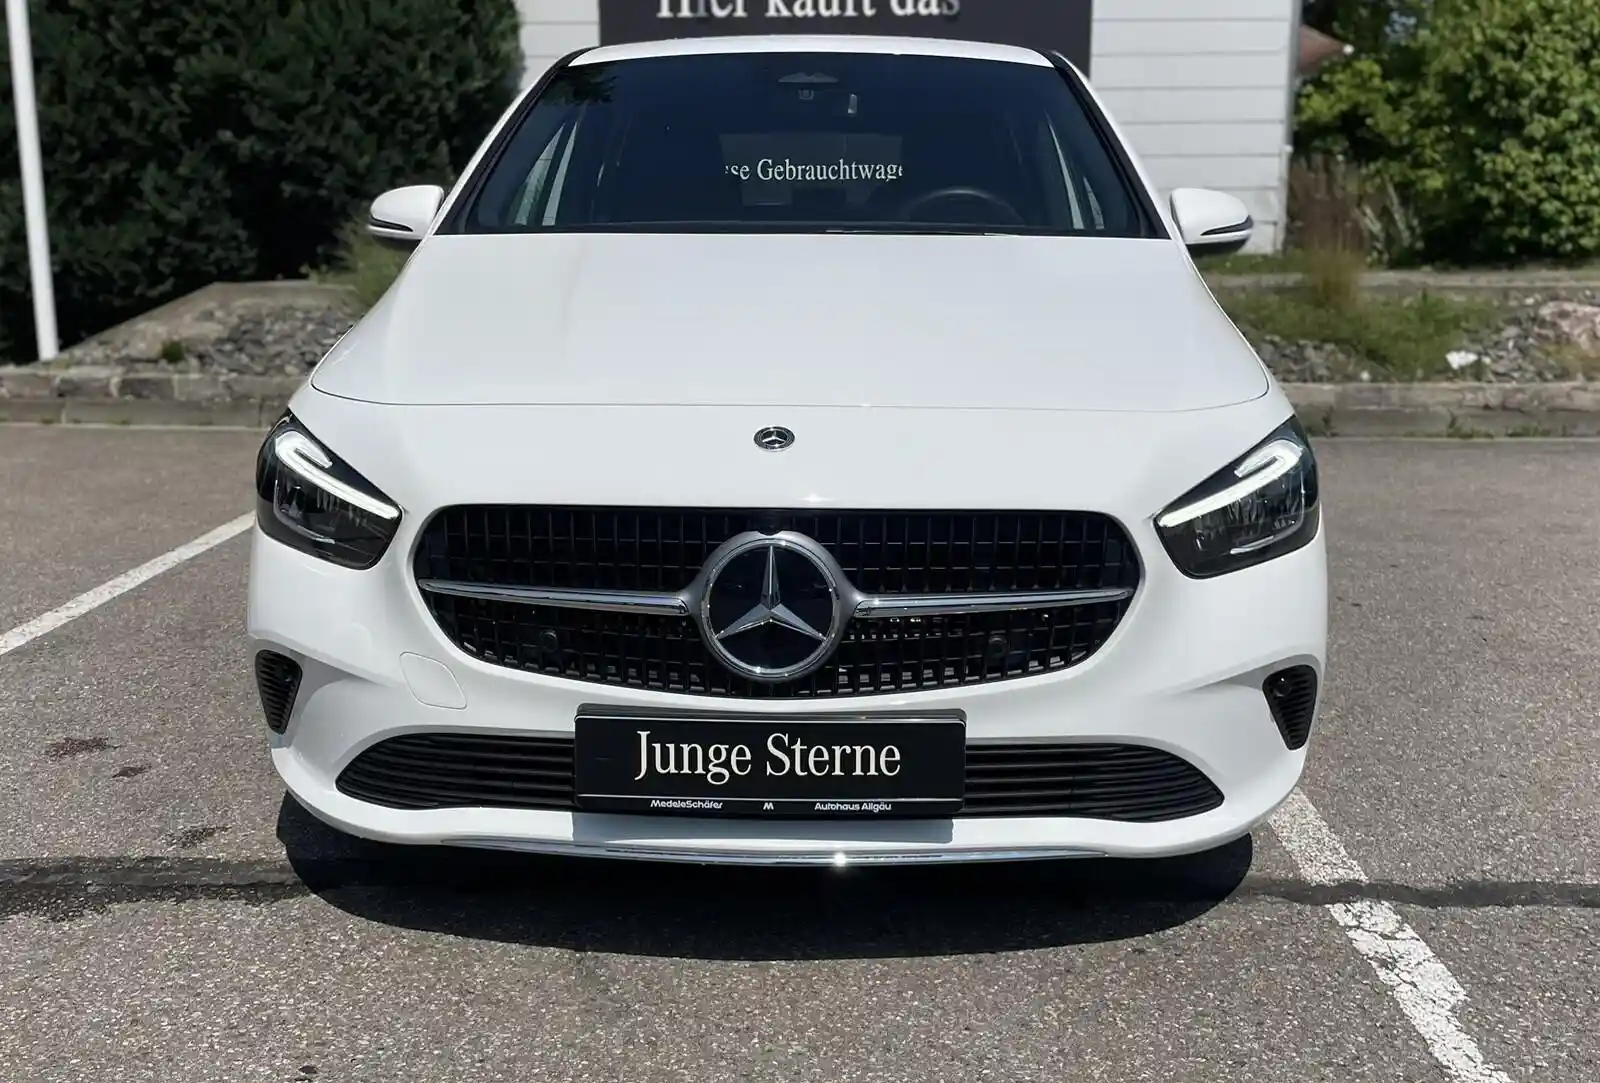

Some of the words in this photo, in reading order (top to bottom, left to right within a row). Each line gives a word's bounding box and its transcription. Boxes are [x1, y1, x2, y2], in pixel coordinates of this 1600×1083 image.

[724, 165, 750, 180] se
[634, 730, 752, 785] Junge
[766, 732, 901, 777] Sterne
[650, 799, 724, 809] MedeleSchäfer
[814, 802, 861, 811] Autohaus
[861, 801, 892, 813] Allgäu
